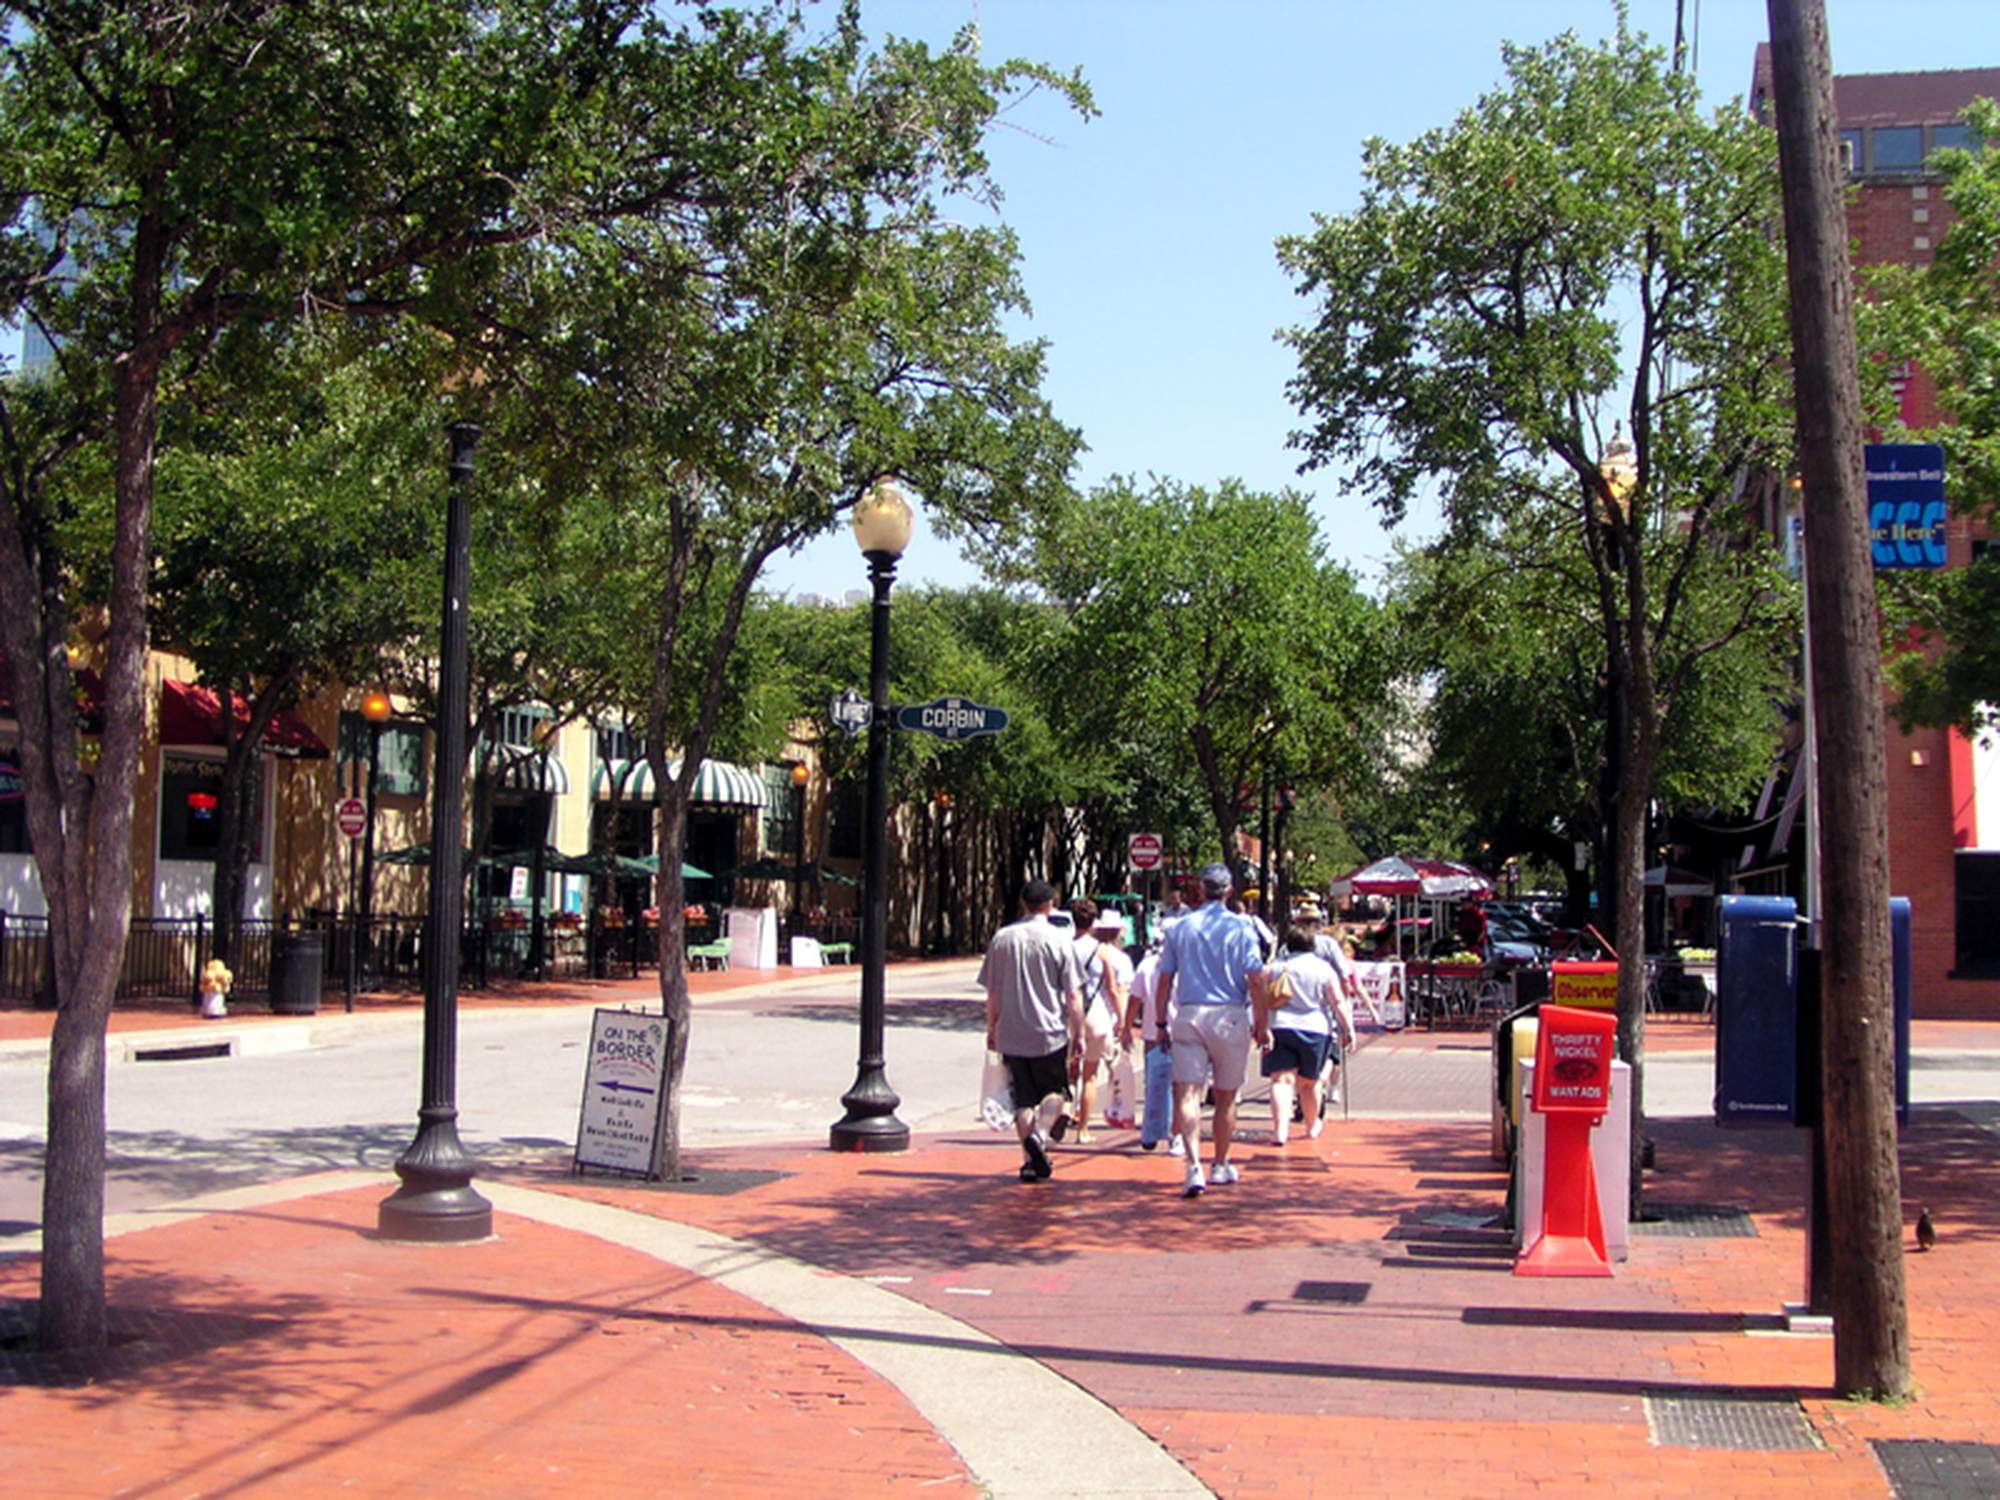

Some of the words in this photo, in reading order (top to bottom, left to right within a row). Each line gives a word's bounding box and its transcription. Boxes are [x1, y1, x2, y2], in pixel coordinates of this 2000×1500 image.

[1866, 471, 1918, 481] hwestern
[1919, 469, 1941, 481] Bell
[922, 708, 986, 728] CORBIN
[1557, 980, 1617, 1000] Observer
[604, 1026, 623, 1040] ON
[626, 1028, 647, 1043] THE
[1550, 1034, 1602, 1045] THRIFTY
[596, 1040, 656, 1065] BORDER
[1553, 1046, 1598, 1058] NICKEL
[1549, 1086, 1580, 1098] WANT
[1580, 1086, 1602, 1098] ADS
